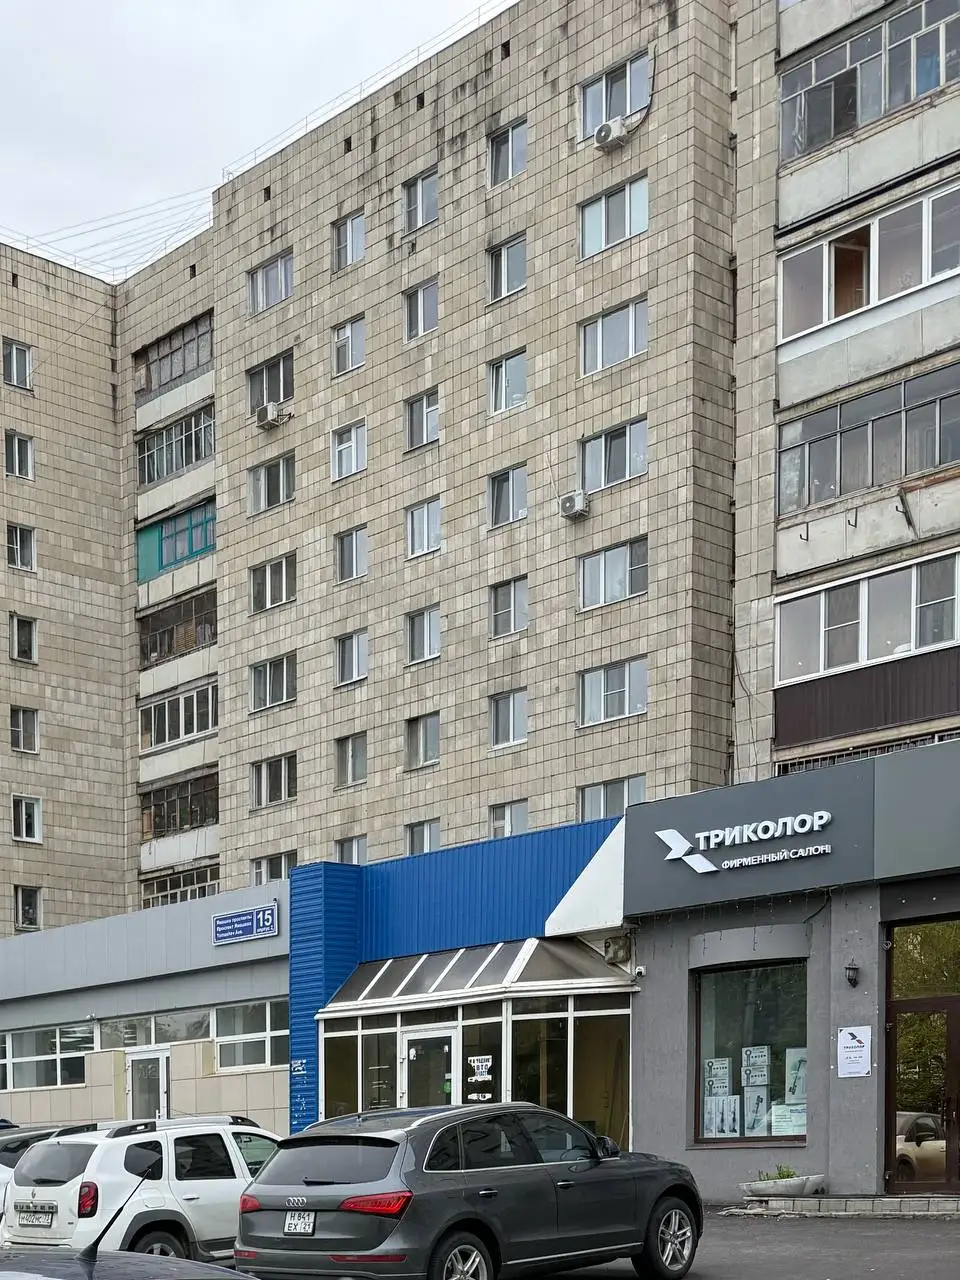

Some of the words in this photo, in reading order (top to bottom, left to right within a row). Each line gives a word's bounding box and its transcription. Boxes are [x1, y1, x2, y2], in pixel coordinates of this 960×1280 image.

[695, 810, 832, 851] ТРИКОЛОР
[721, 851, 788, 870] ФИРМЕННЫЙ
[789, 844, 832, 859] САЛОН
[257, 910, 273, 927] 15
